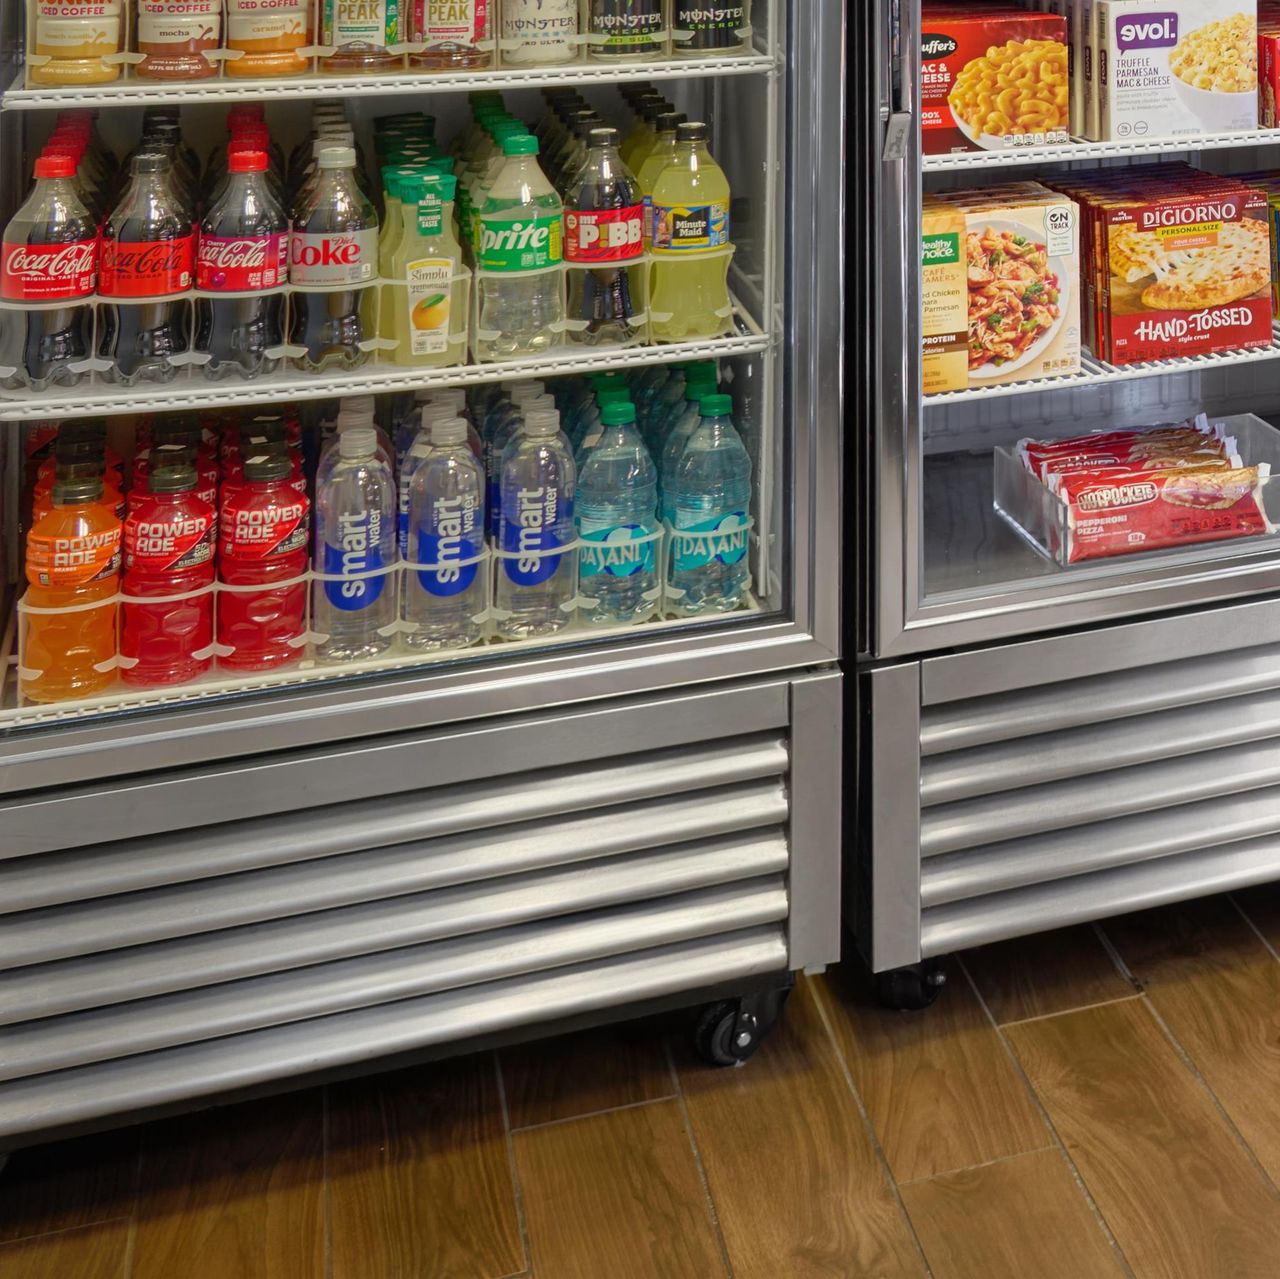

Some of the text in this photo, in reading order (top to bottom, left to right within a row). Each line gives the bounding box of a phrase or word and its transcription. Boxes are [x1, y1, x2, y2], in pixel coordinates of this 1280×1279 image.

[41, 7, 105, 16] ICED COFFEE
[338, 3, 380, 20] PEAK
[594, 12, 661, 28] MONSTER
[601, 27, 656, 35] ENERGY
[1121, 19, 1176, 42] evol.
[1117, 58, 1150, 68] TRUFFLE
[1117, 67, 1159, 78] PARMESAN
[1117, 76, 1171, 88] MAC & CHEESE
[1050, 221, 1069, 229] TRACK
[6, 243, 95, 276] Coca-Cola
[137, 518, 207, 541] POWER
[235, 525, 275, 539] ADE
[369, 508, 381, 548] water
[341, 511, 366, 598] smart
[683, 533, 745, 564] DASANI
